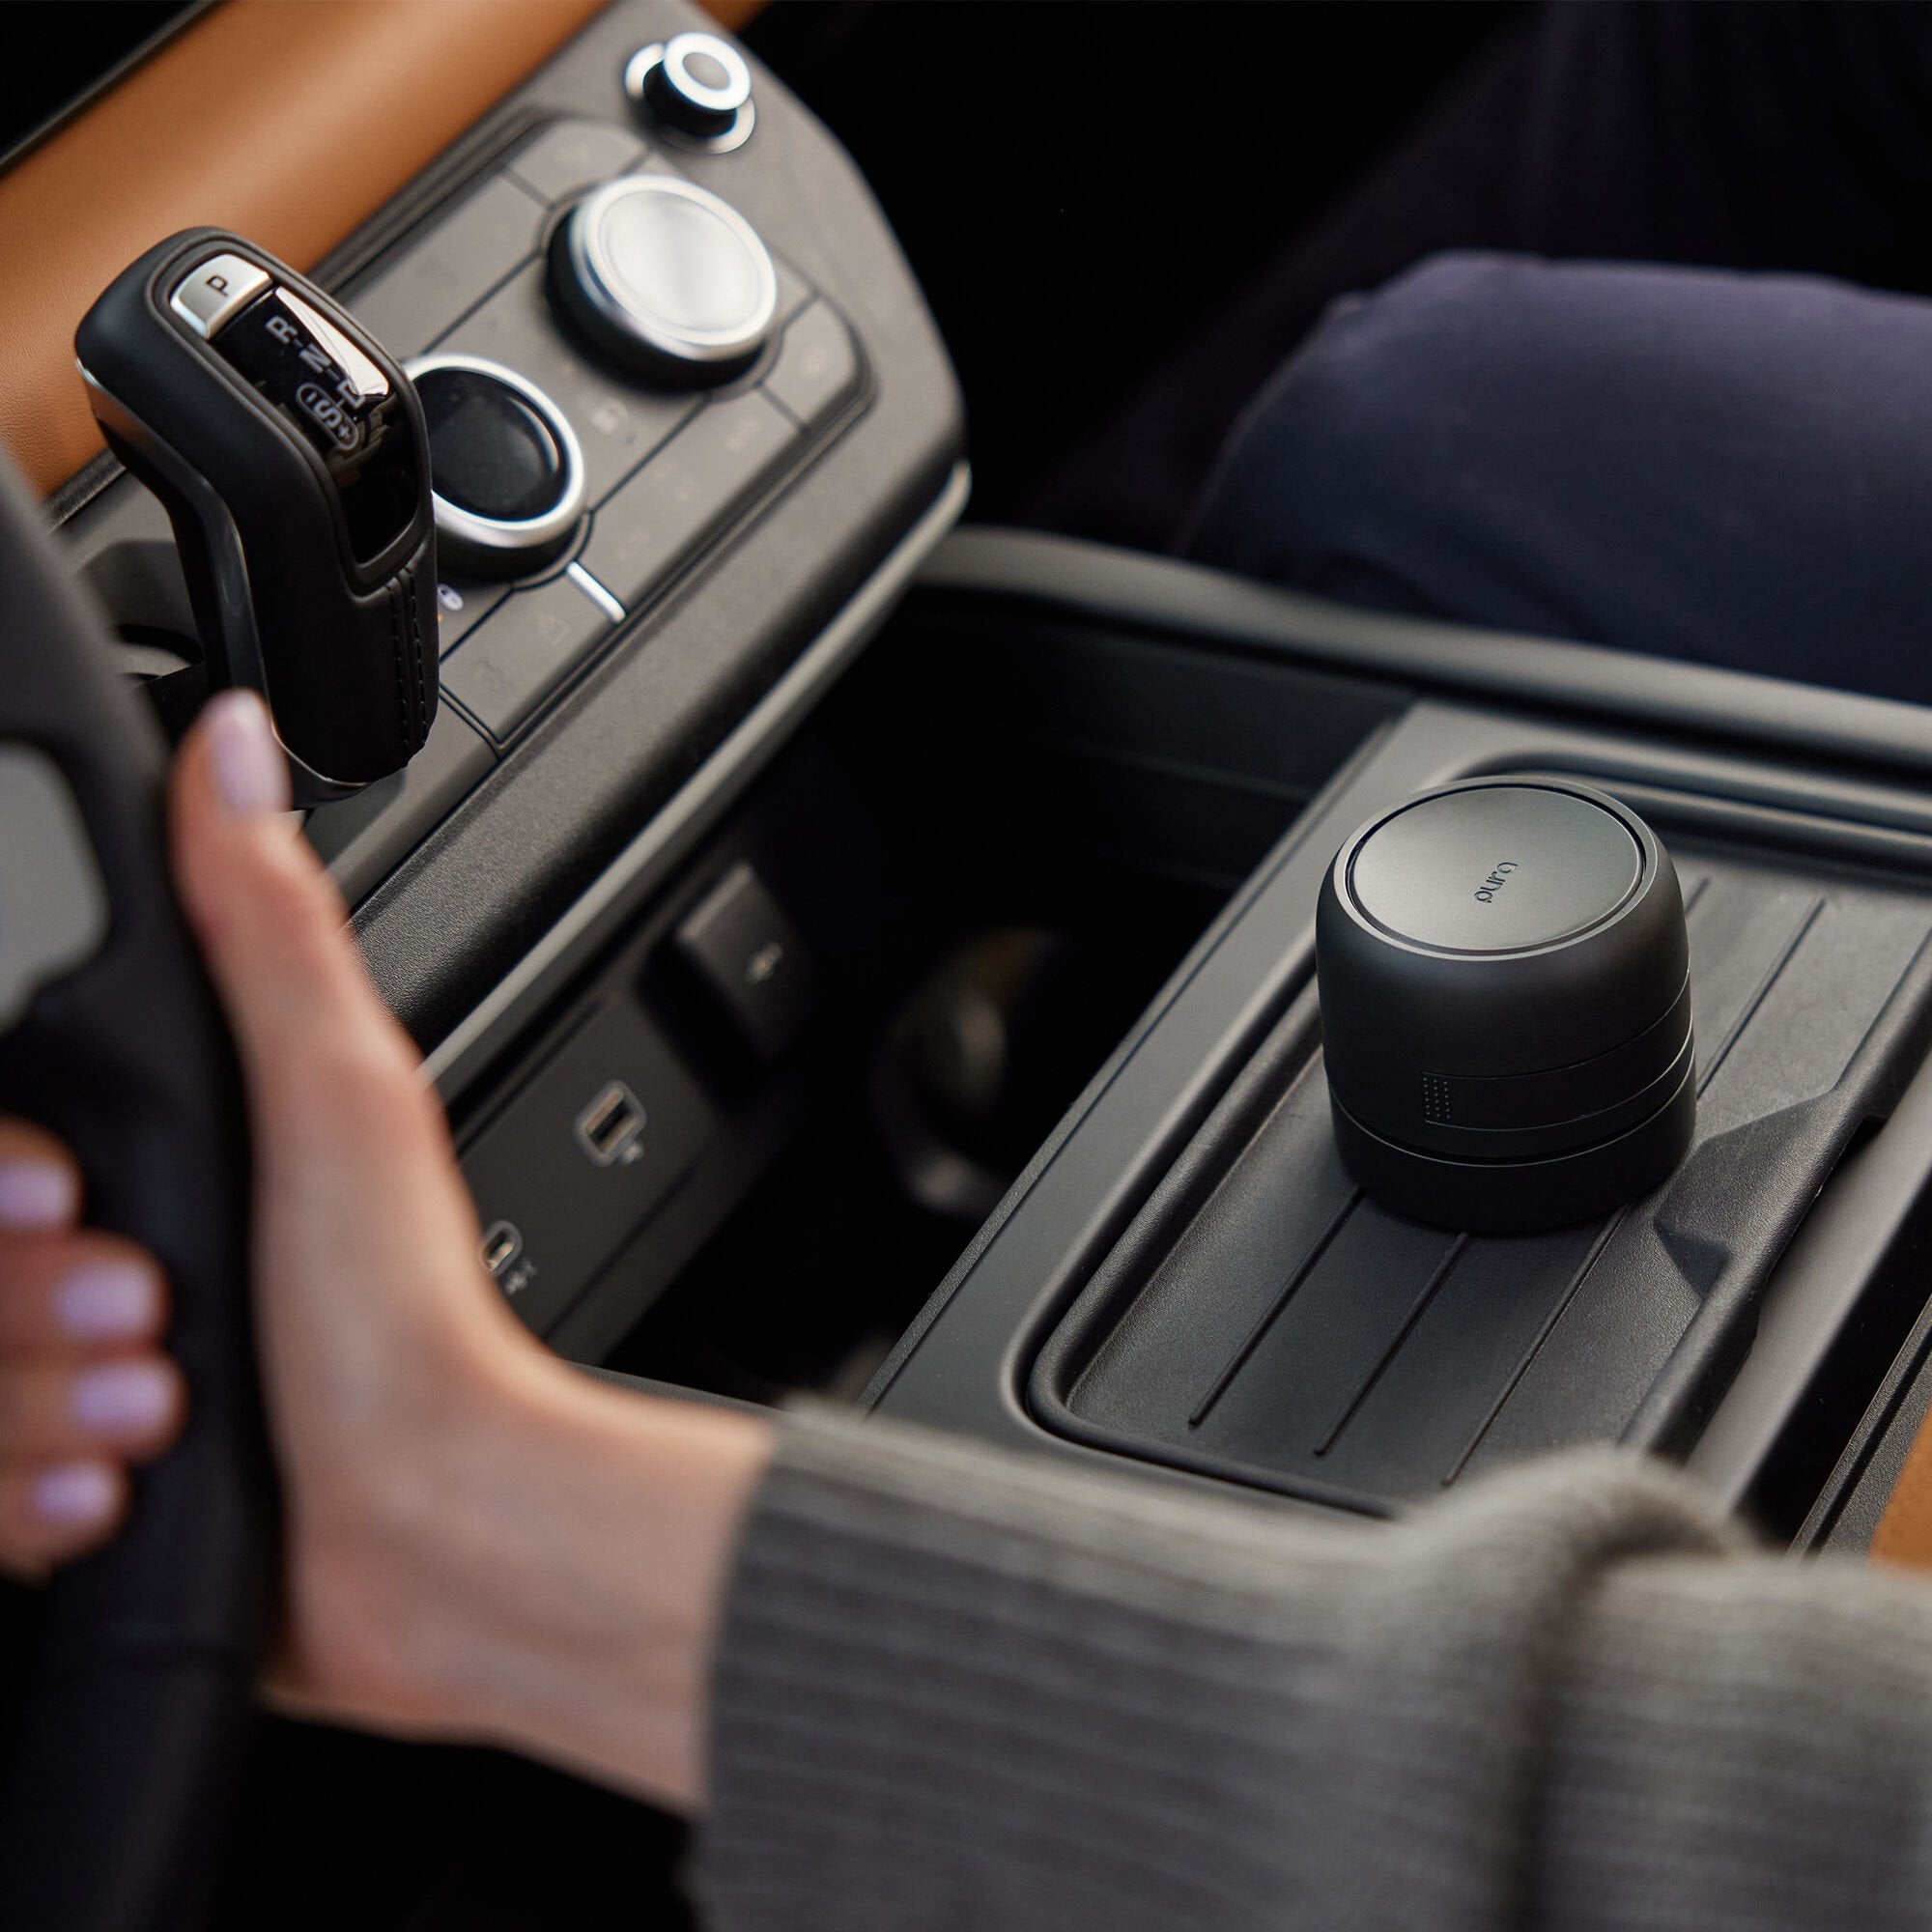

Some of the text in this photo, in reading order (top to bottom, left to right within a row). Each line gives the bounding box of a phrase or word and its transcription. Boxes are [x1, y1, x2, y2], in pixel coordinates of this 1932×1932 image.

[205, 274, 229, 298] P
[265, 315, 298, 345] R
[298, 342, 332, 374] N
[1473, 862, 1519, 903] pura
